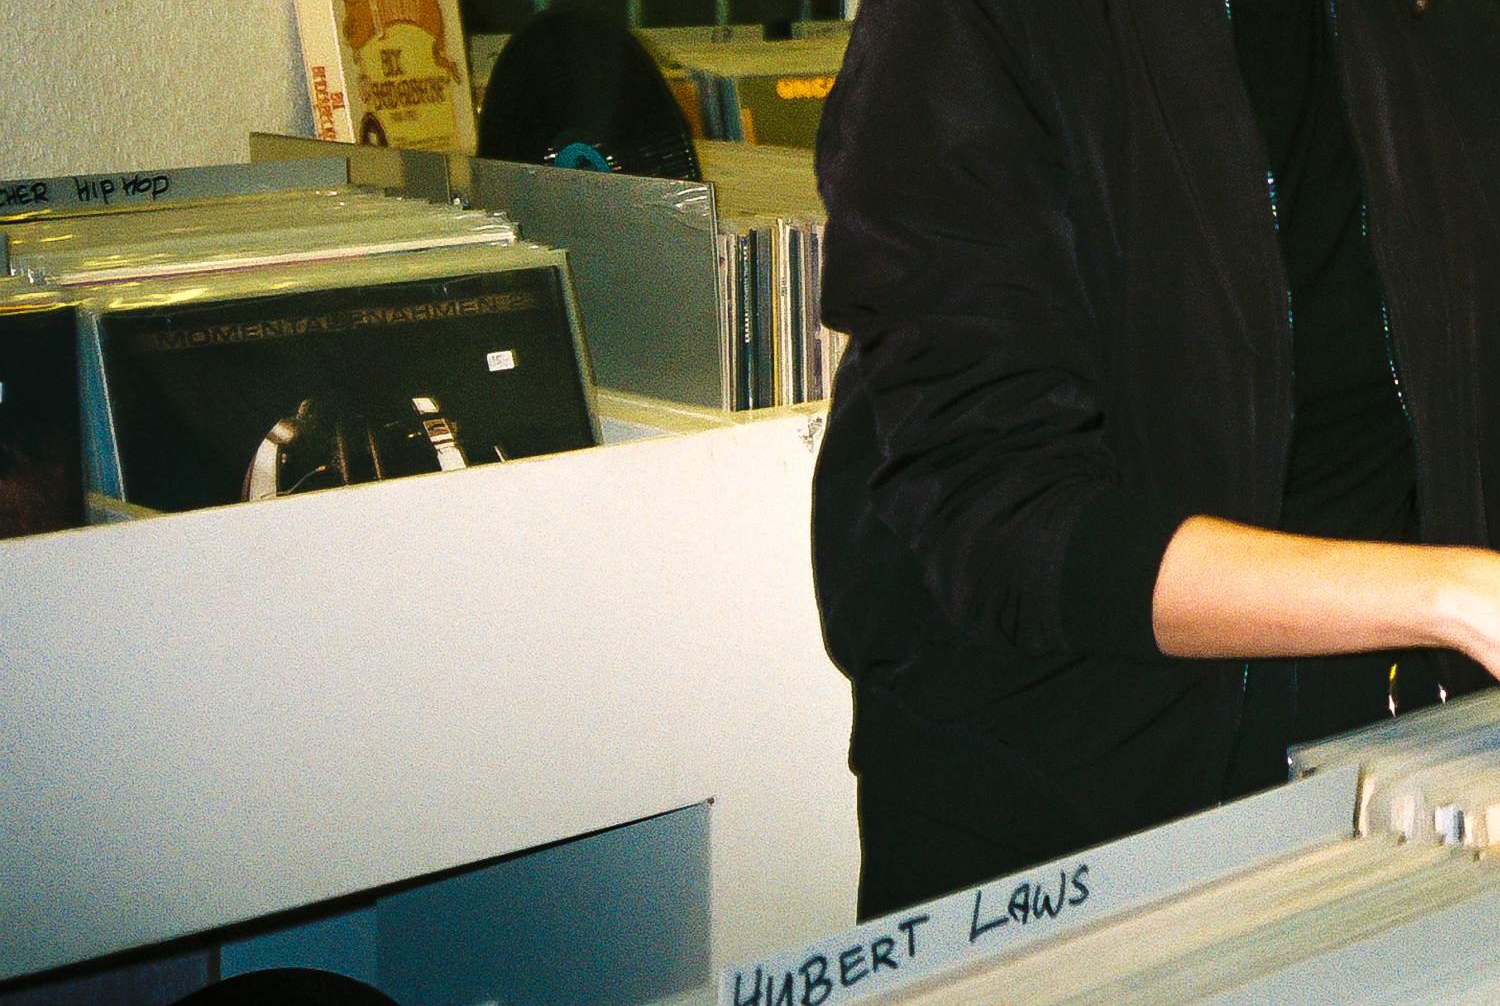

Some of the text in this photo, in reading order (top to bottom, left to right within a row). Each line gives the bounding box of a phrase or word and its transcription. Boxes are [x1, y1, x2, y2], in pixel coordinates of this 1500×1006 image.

[74, 176, 116, 204] HIP
[122, 175, 170, 201] HOP
[734, 864, 1090, 1006] HUBERT LAWS
